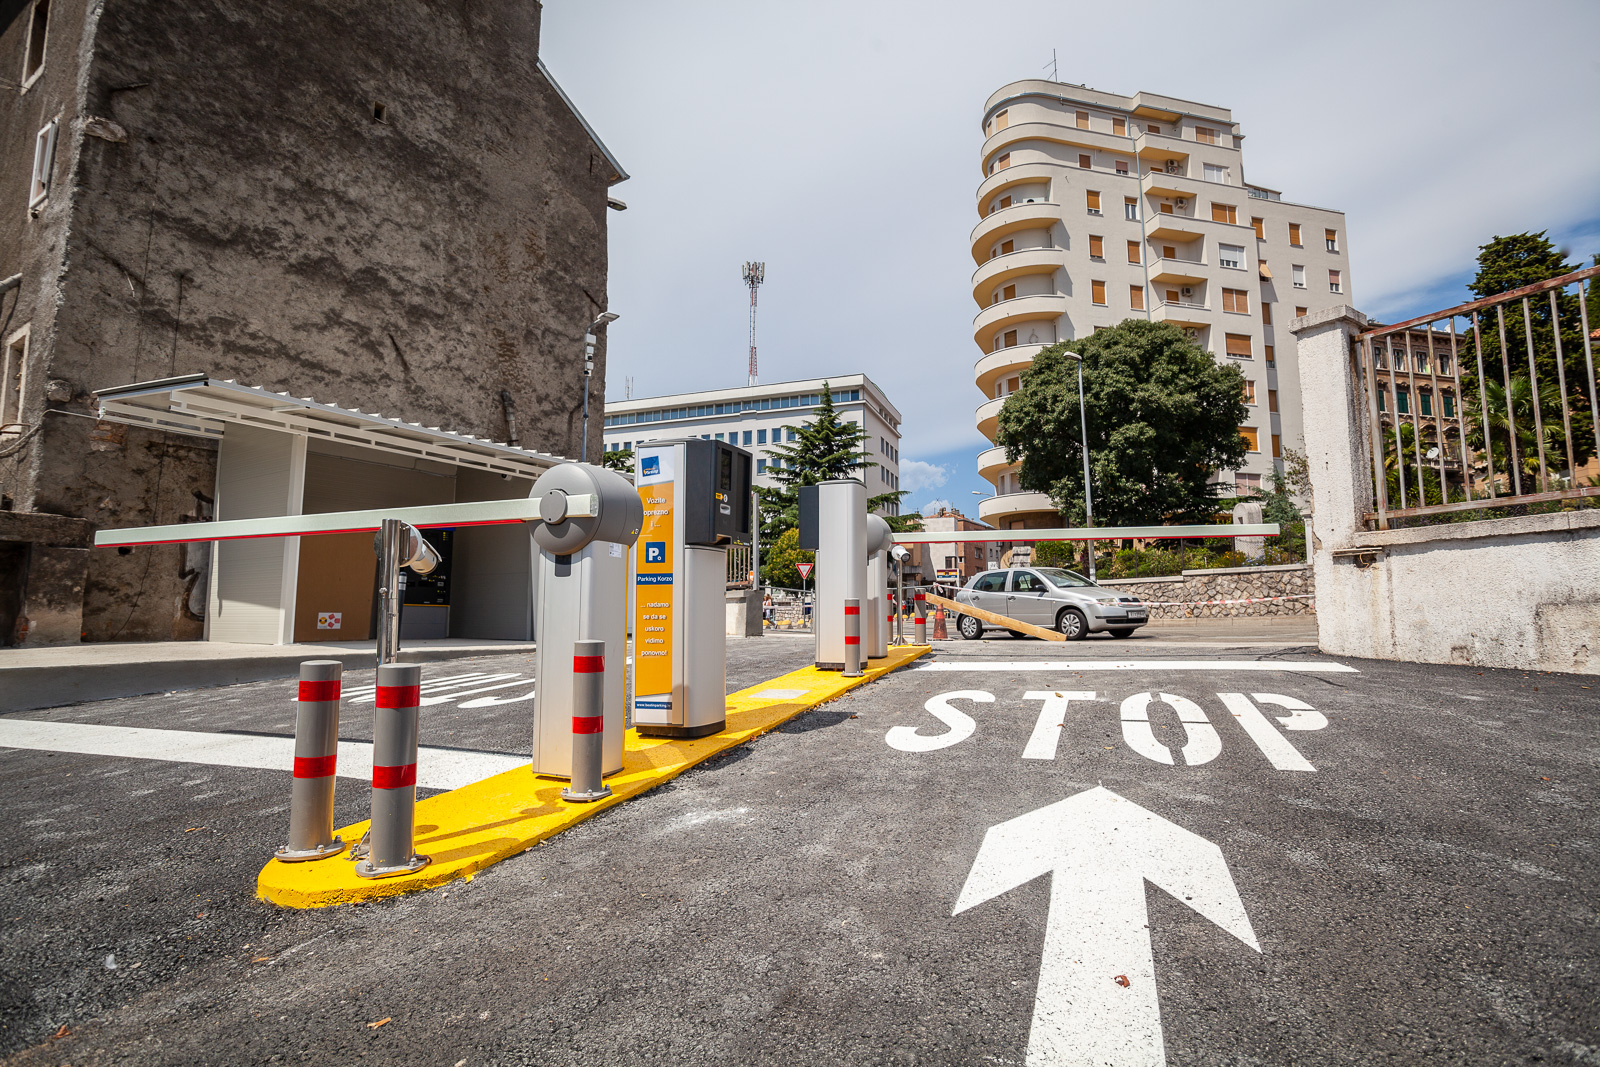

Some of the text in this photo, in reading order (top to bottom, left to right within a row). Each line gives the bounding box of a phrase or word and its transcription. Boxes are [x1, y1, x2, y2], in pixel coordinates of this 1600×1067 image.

[643, 509, 669, 517] oprezno
[641, 649, 668, 657] ponovno!
[885, 689, 1329, 772] STOP
